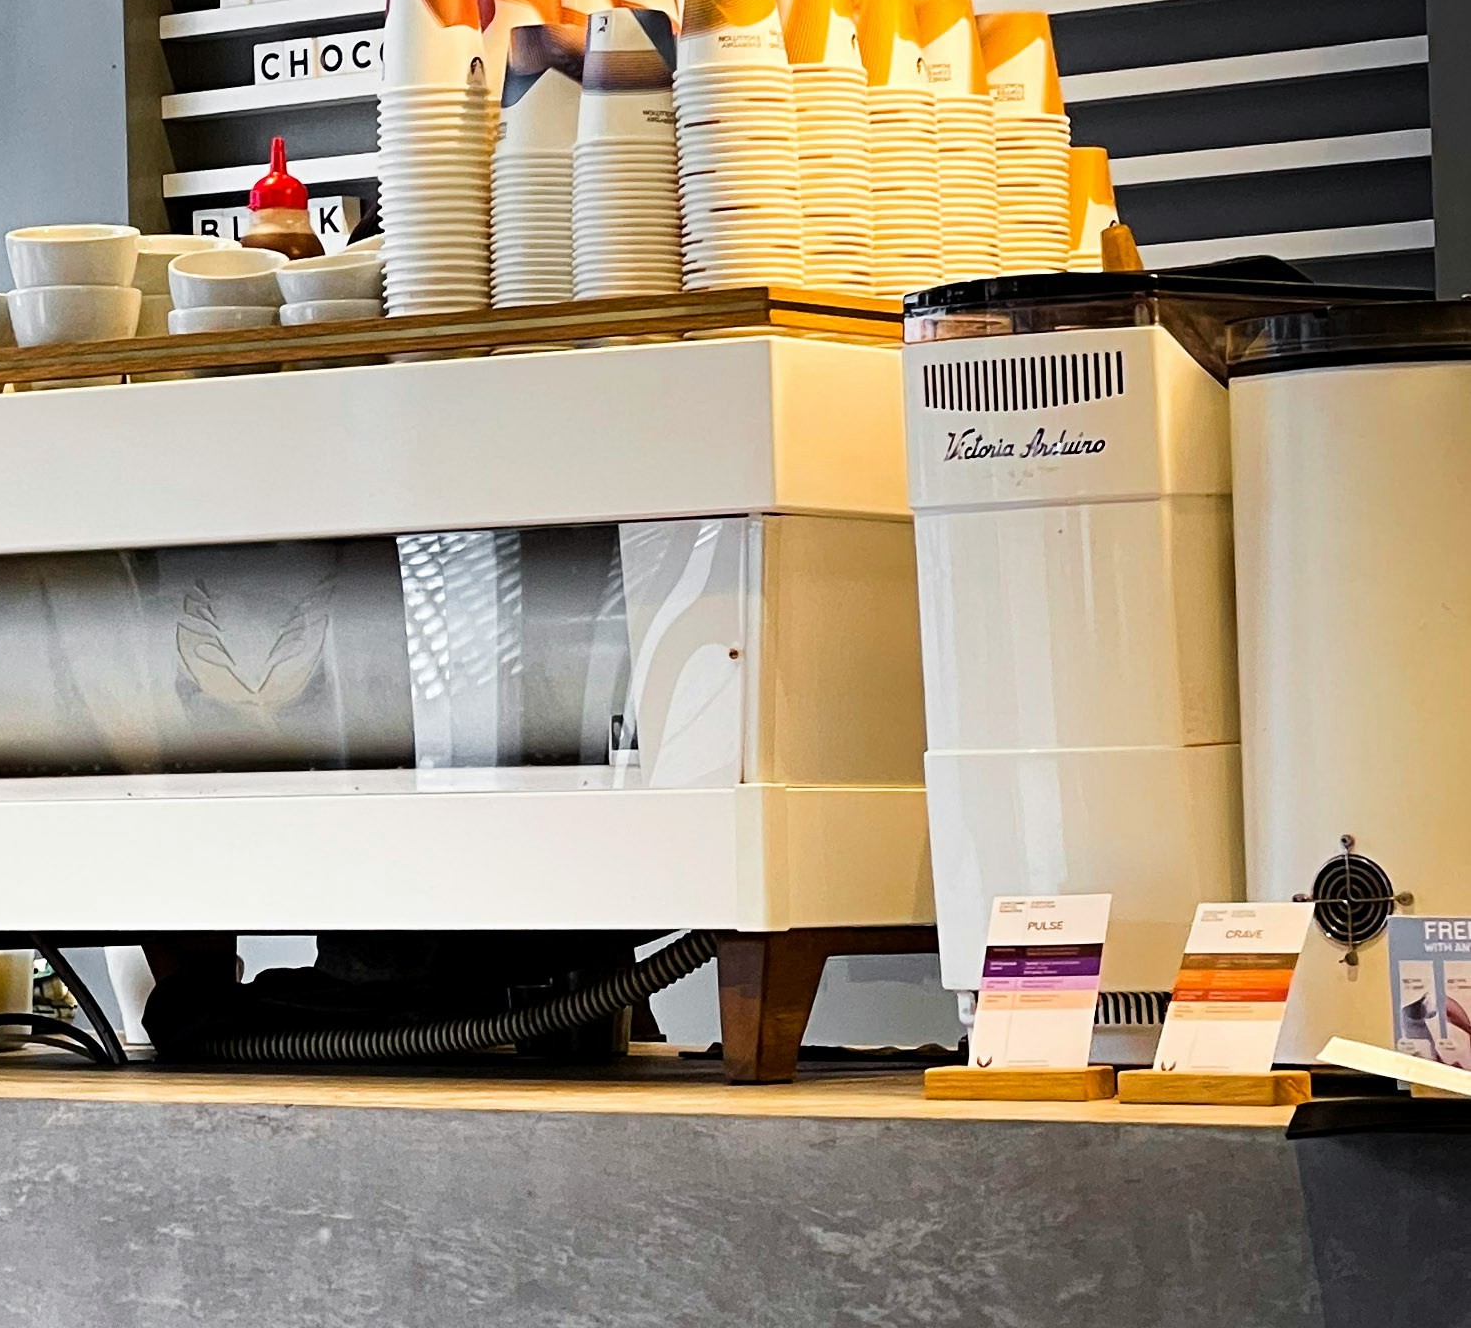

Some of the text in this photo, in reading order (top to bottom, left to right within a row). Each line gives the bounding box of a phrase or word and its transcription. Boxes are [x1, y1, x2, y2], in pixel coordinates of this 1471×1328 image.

[261, 40, 384, 80] CHOC
[200, 205, 340, 242] BLK
[944, 427, 1106, 462] Victoria Arduino
[1027, 920, 1064, 931] PULSE
[1225, 929, 1264, 939] CRAVE
[1424, 920, 1471, 941] FRE
[1424, 942, 1453, 953] WITH
